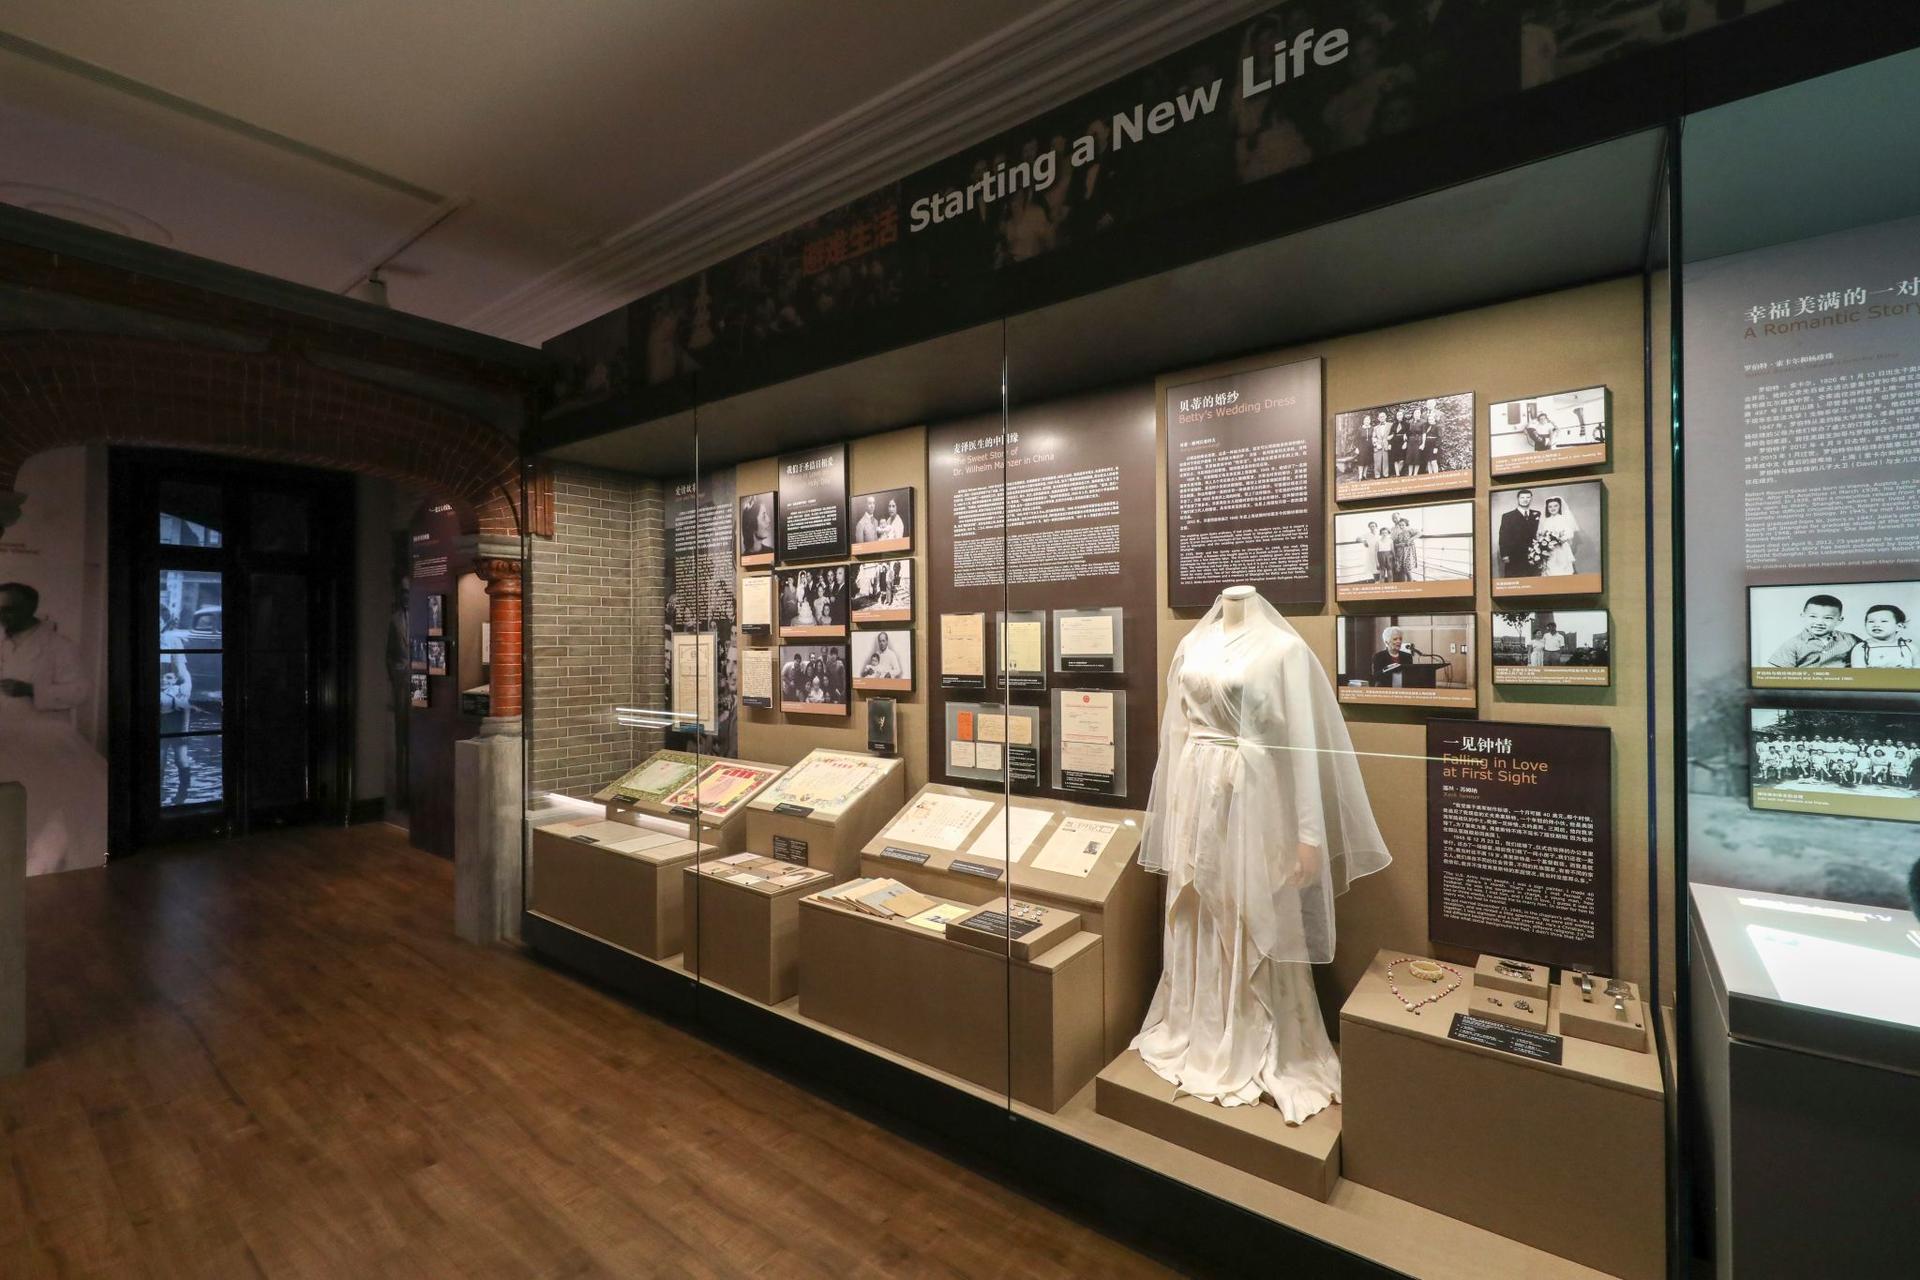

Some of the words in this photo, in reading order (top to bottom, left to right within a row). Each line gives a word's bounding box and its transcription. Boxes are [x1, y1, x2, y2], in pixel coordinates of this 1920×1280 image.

[910, 151, 1056, 232] Starting
[1071, 135, 1095, 168] a
[1112, 80, 1223, 152] New
[1242, 28, 1349, 99] Life
[1744, 277, 1920, 324] 幸福美满的一对
[1744, 327, 1758, 340] A
[1764, 309, 1861, 336] Romantic
[1179, 410, 1213, 424] Betty's
[1216, 401, 1261, 417] Wedding
[1264, 396, 1297, 409] Dress
[966, 463, 993, 474] Wilhelm
[994, 459, 1022, 470] Manzer
[1033, 453, 1055, 463] China
[967, 453, 988, 463] Sweet
[1443, 736, 1512, 754] 一见钟情
[1443, 753, 1488, 769] Falling
[1494, 756, 1507, 768] in
[1512, 758, 1549, 772] Love
[1443, 767, 1457, 777] at
[1462, 767, 1493, 781] First
[1498, 771, 1538, 785] Sight
